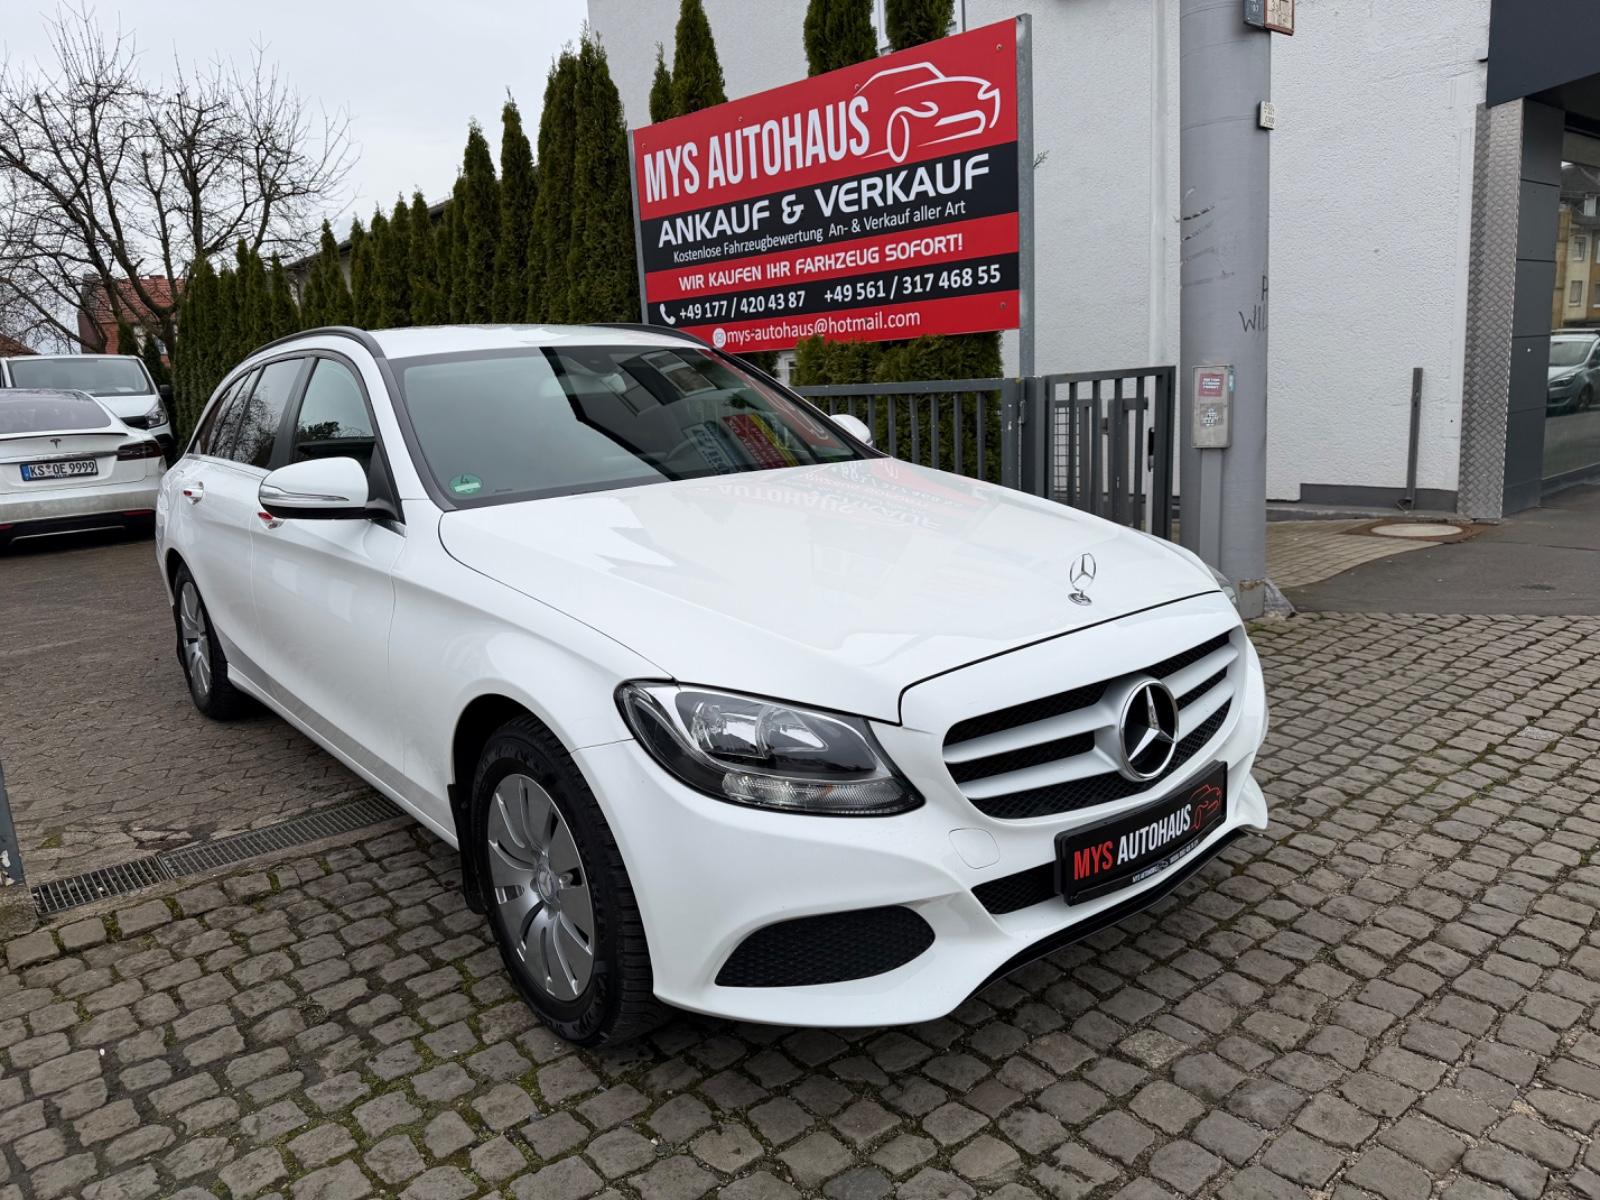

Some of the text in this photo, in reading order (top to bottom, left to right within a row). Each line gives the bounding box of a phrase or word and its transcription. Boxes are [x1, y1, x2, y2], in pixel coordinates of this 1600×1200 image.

[643, 95, 870, 203] MYS AUTOHAUS
[658, 153, 989, 248] ANKAUF & VERKAUF
[673, 200, 966, 264] Kostenlose Fahrzeugbewertung An- & Verkauf aller Art
[678, 233, 963, 291] WIR KAUFEN IHR FARHZEUG SOFORT!
[824, 264, 1001, 302] +49 561 / 317 468 55
[679, 291, 806, 320] +49 177 / 420 43 87
[727, 311, 921, 345] mys-autohaus@hotmail.com
[30, 465, 45, 477] KS
[69, 461, 95, 473] 9999
[1073, 840, 1114, 880] MYS
[1116, 803, 1192, 866] AUTOHAUS
